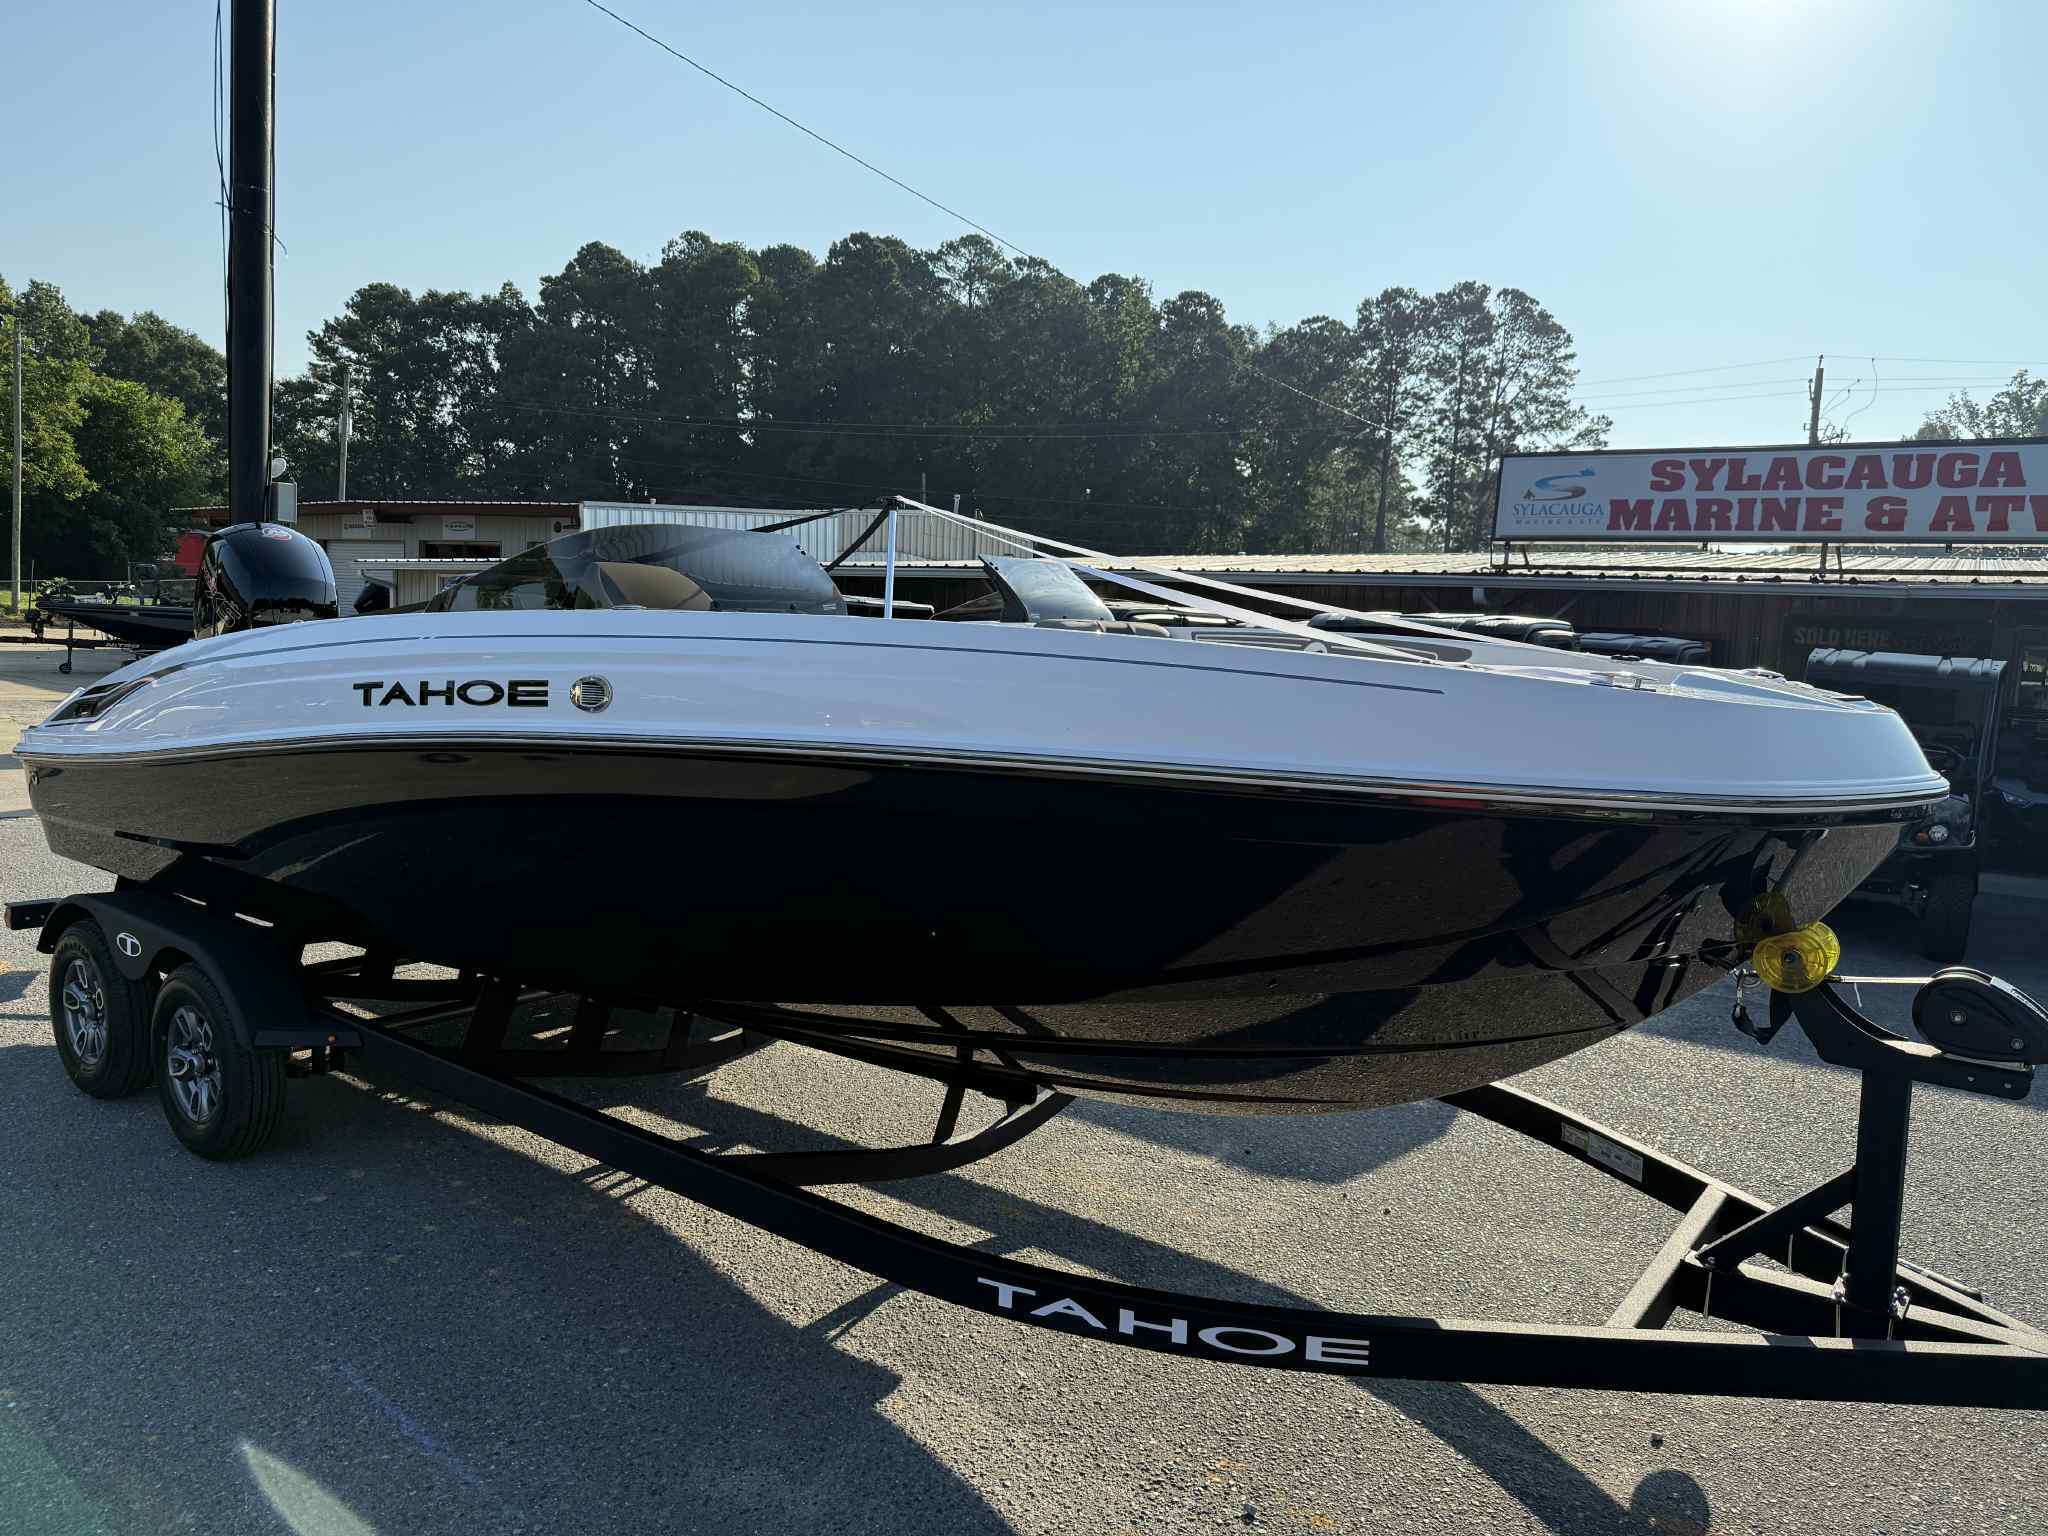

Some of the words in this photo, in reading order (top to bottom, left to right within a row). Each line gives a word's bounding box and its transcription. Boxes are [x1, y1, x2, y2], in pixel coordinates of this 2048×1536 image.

[1649, 451, 2025, 491] SYLACAUGA
[1512, 503, 1604, 516] SYLACAUGA
[1606, 495, 1842, 531] MARINE
[1864, 494, 1908, 531] &
[1793, 627, 1841, 646] SOLD
[353, 680, 549, 707] TAHOE
[977, 1277, 1370, 1366] TAHOE
